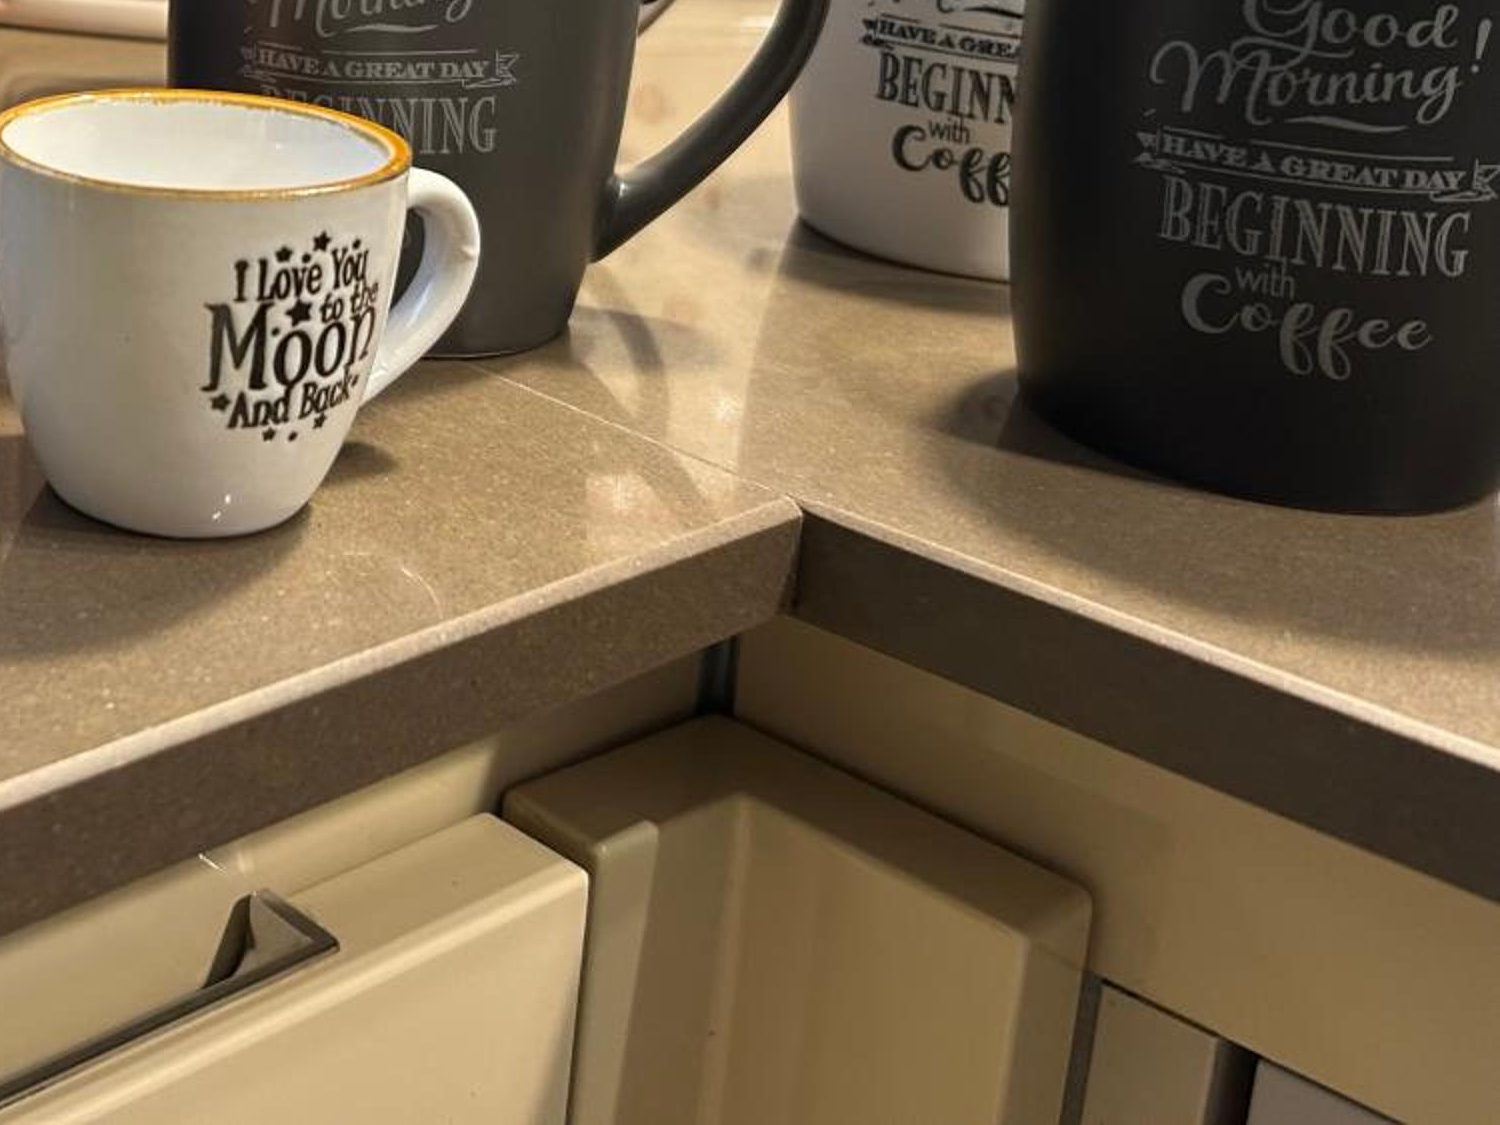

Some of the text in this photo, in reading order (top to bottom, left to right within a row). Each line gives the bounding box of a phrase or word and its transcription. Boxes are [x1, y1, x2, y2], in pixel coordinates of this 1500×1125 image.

[257, 47, 489, 78] HAVE A GREAT DAY
[879, 19, 936, 46] HAVE
[938, 34, 955, 49] A
[875, 50, 1014, 125] BEGINN
[927, 114, 971, 145] with
[892, 124, 1011, 207] Coff
[1163, 134, 1468, 192] HAVE A GREAT DAY
[1158, 175, 1472, 278] BEGINNING
[233, 247, 369, 302] I Love You
[320, 282, 379, 324] to the
[1235, 257, 1296, 299] with
[201, 302, 376, 392] Moon
[1181, 273, 1433, 380] Coffee
[226, 364, 352, 430] And Back
